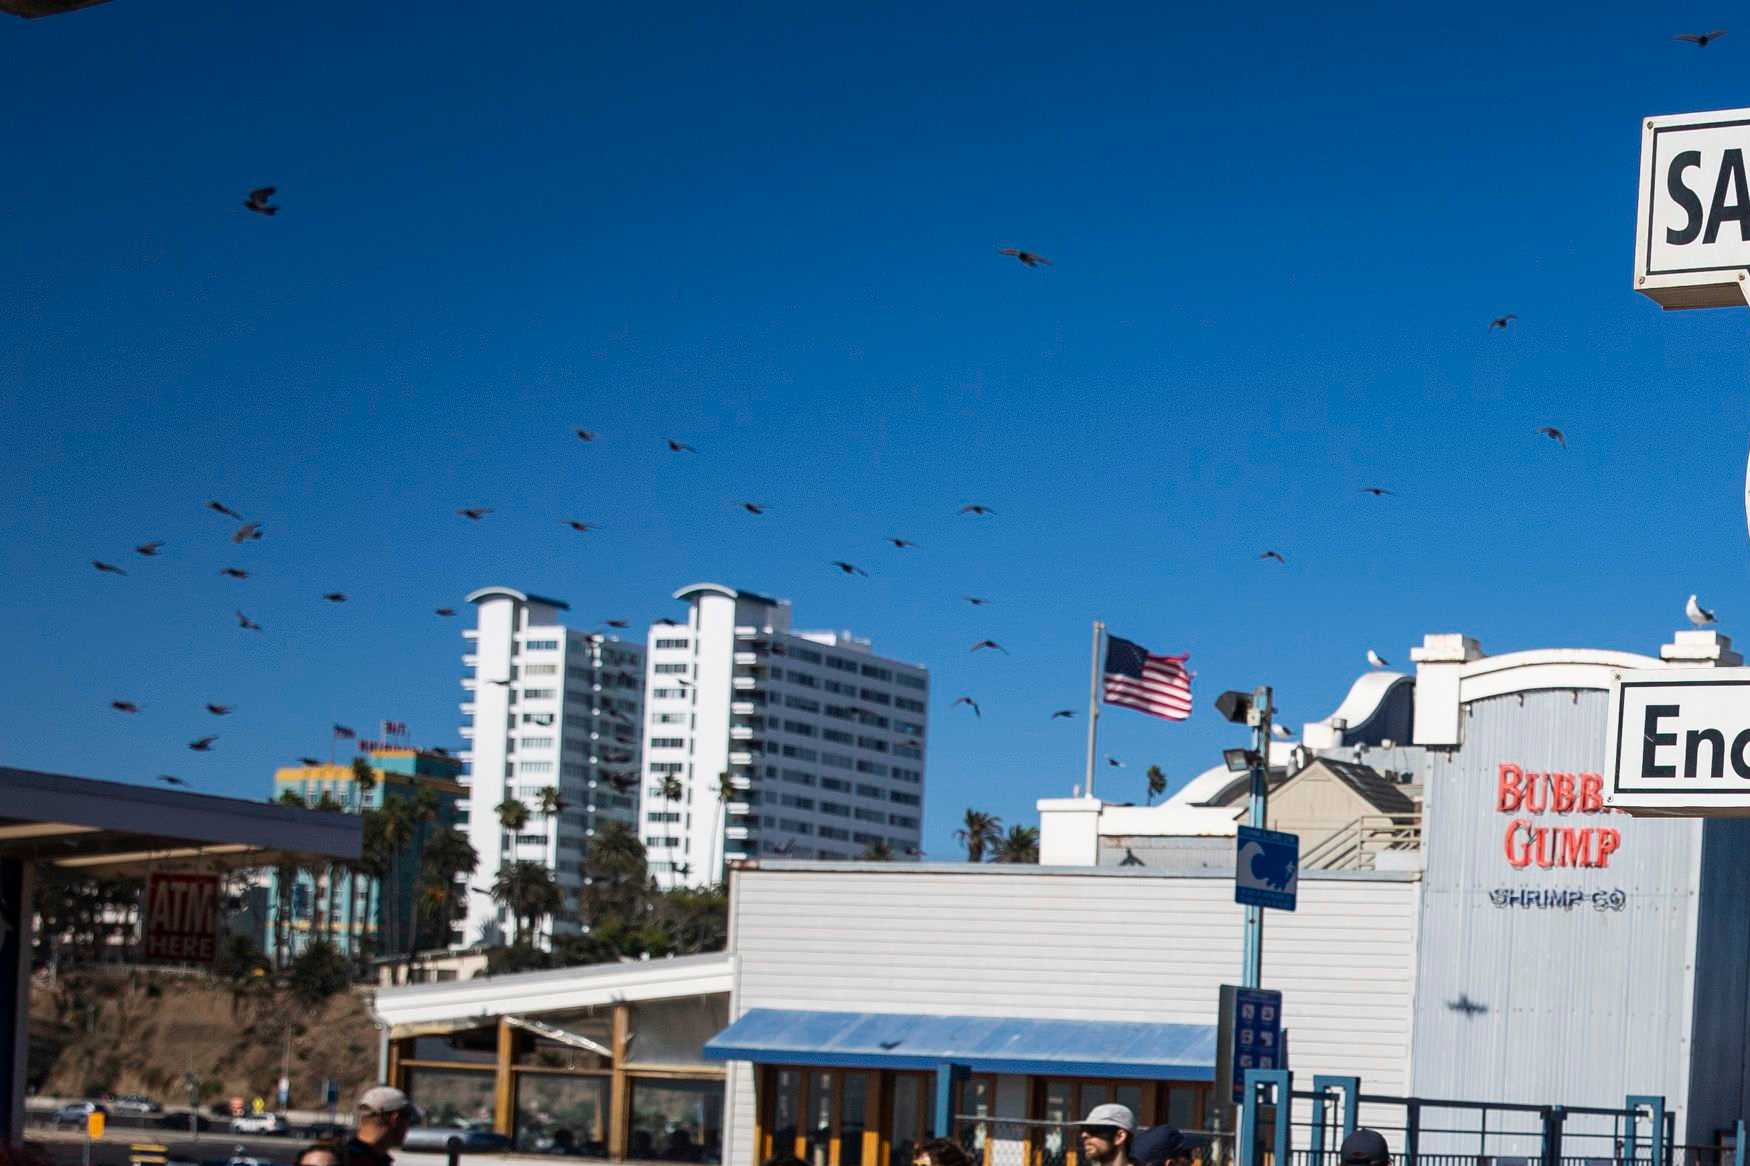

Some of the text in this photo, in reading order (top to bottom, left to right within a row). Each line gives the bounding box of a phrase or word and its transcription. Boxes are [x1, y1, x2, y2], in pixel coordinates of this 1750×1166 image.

[1496, 762, 1608, 815] BUBB
[1504, 819, 1621, 869] GUMP
[150, 880, 216, 933] ATM
[1490, 887, 1583, 910] SHRIMP
[148, 934, 214, 957] HERE
